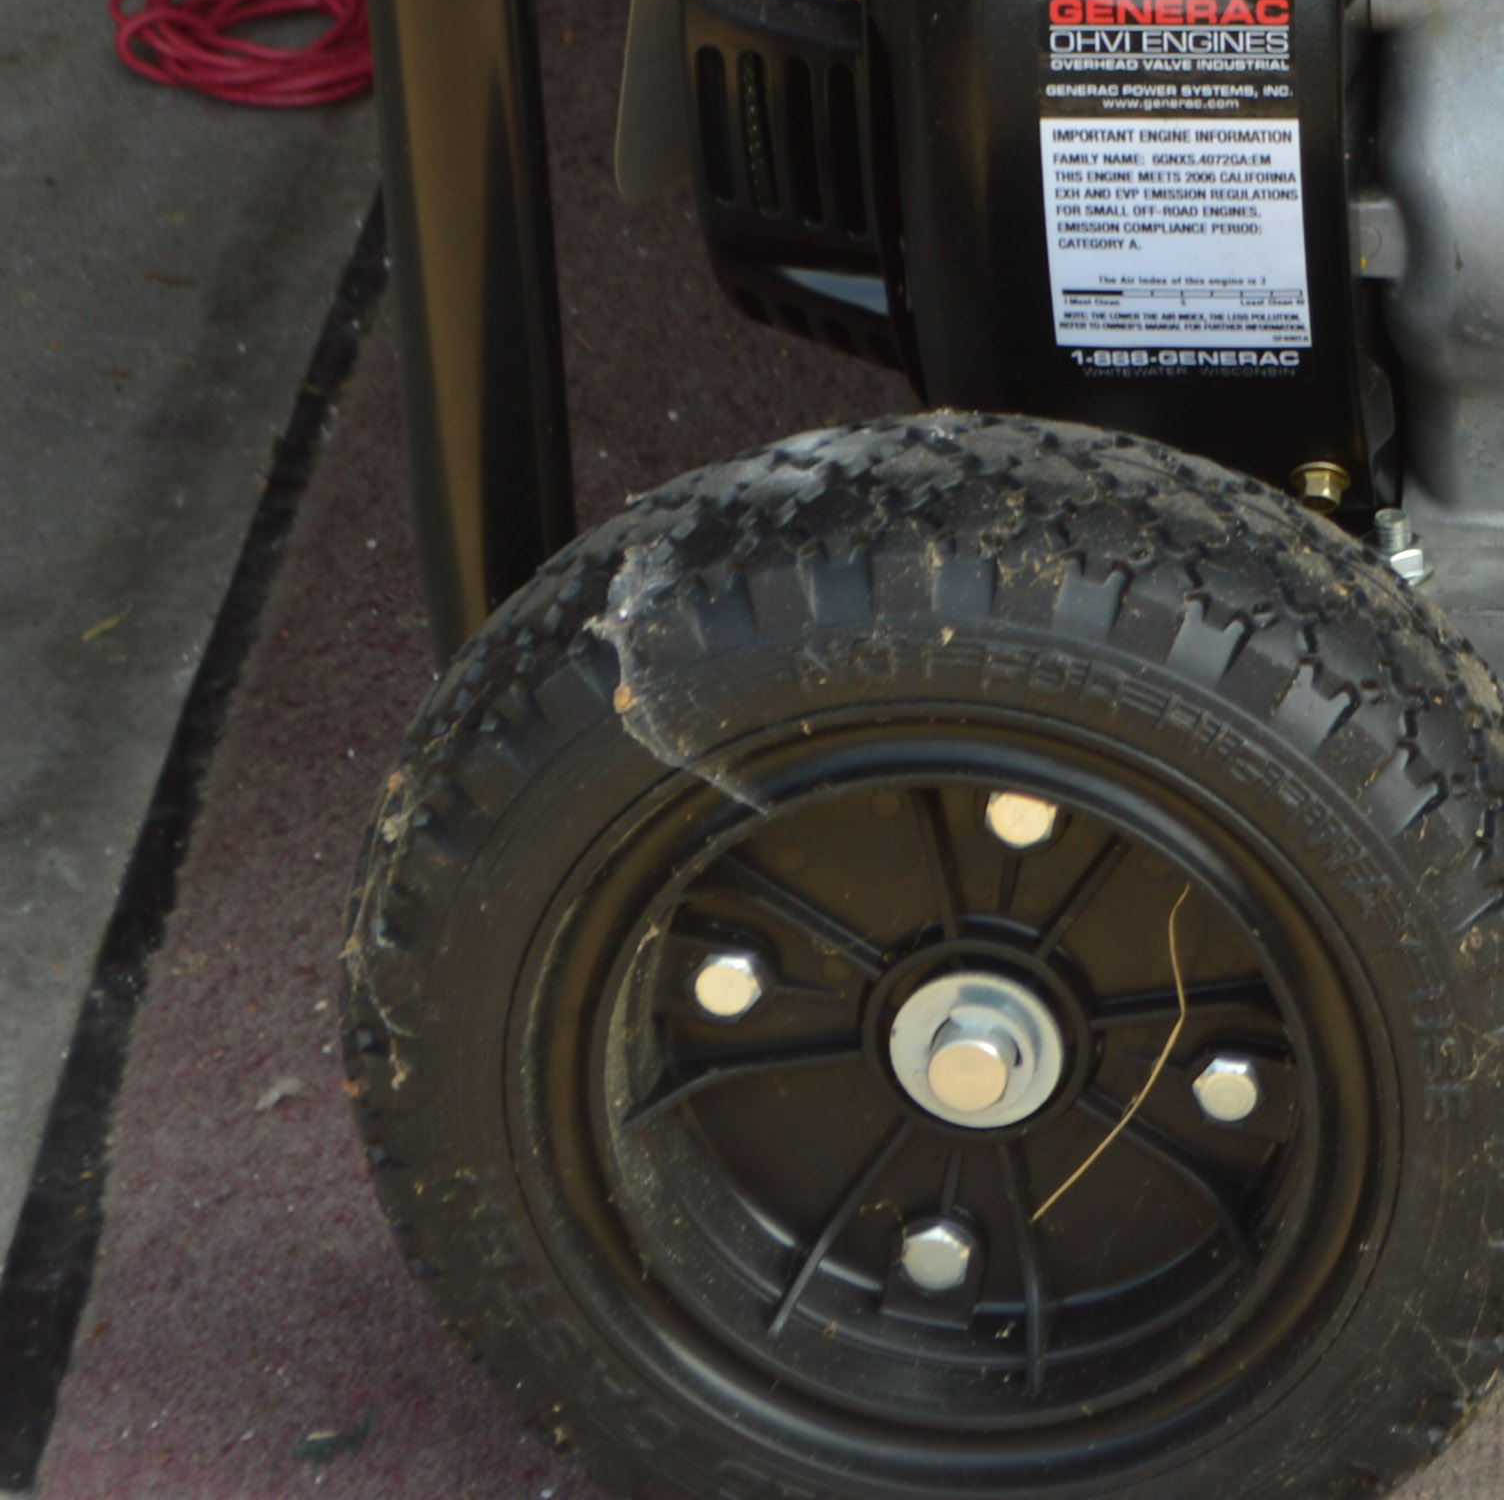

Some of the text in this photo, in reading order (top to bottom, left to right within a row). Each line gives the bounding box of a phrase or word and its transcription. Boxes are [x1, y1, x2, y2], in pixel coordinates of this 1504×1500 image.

[1050, 30, 1289, 54] OHVI ENGINES
[1051, 59, 1289, 72] OVERHEAD VALVE INDUSTRIAL
[1046, 84, 1293, 99] GENERAC POWER SYSTEMS, INC.
[1102, 97, 1240, 111] www.generac.com
[1052, 130, 1292, 144] IMPORTANT ENGINE INFORMATION
[1053, 154, 1099, 166] FAMILY
[1103, 154, 1145, 166] NAME:
[1055, 171, 1083, 183] THIS
[1087, 171, 1133, 183] ENGINE
[1138, 171, 1181, 183] MEETS
[1219, 171, 1297, 183] CALIFORNIA
[1055, 188, 1080, 200] EXH
[1084, 188, 1112, 200] AND
[1144, 188, 1206, 200] EMISSION
[1210, 188, 1298, 200] REGULATIONS
[1056, 205, 1081, 217] FOR
[1085, 205, 1127, 217] SMALL
[1133, 205, 1198, 217] OFF-ROAD
[1057, 222, 1119, 234] EMISSION
[1123, 222, 1207, 234] COMPLIANCE
[1058, 238, 1124, 250] CATEGORY
[1071, 350, 1300, 366] 1-888-GENERAC
